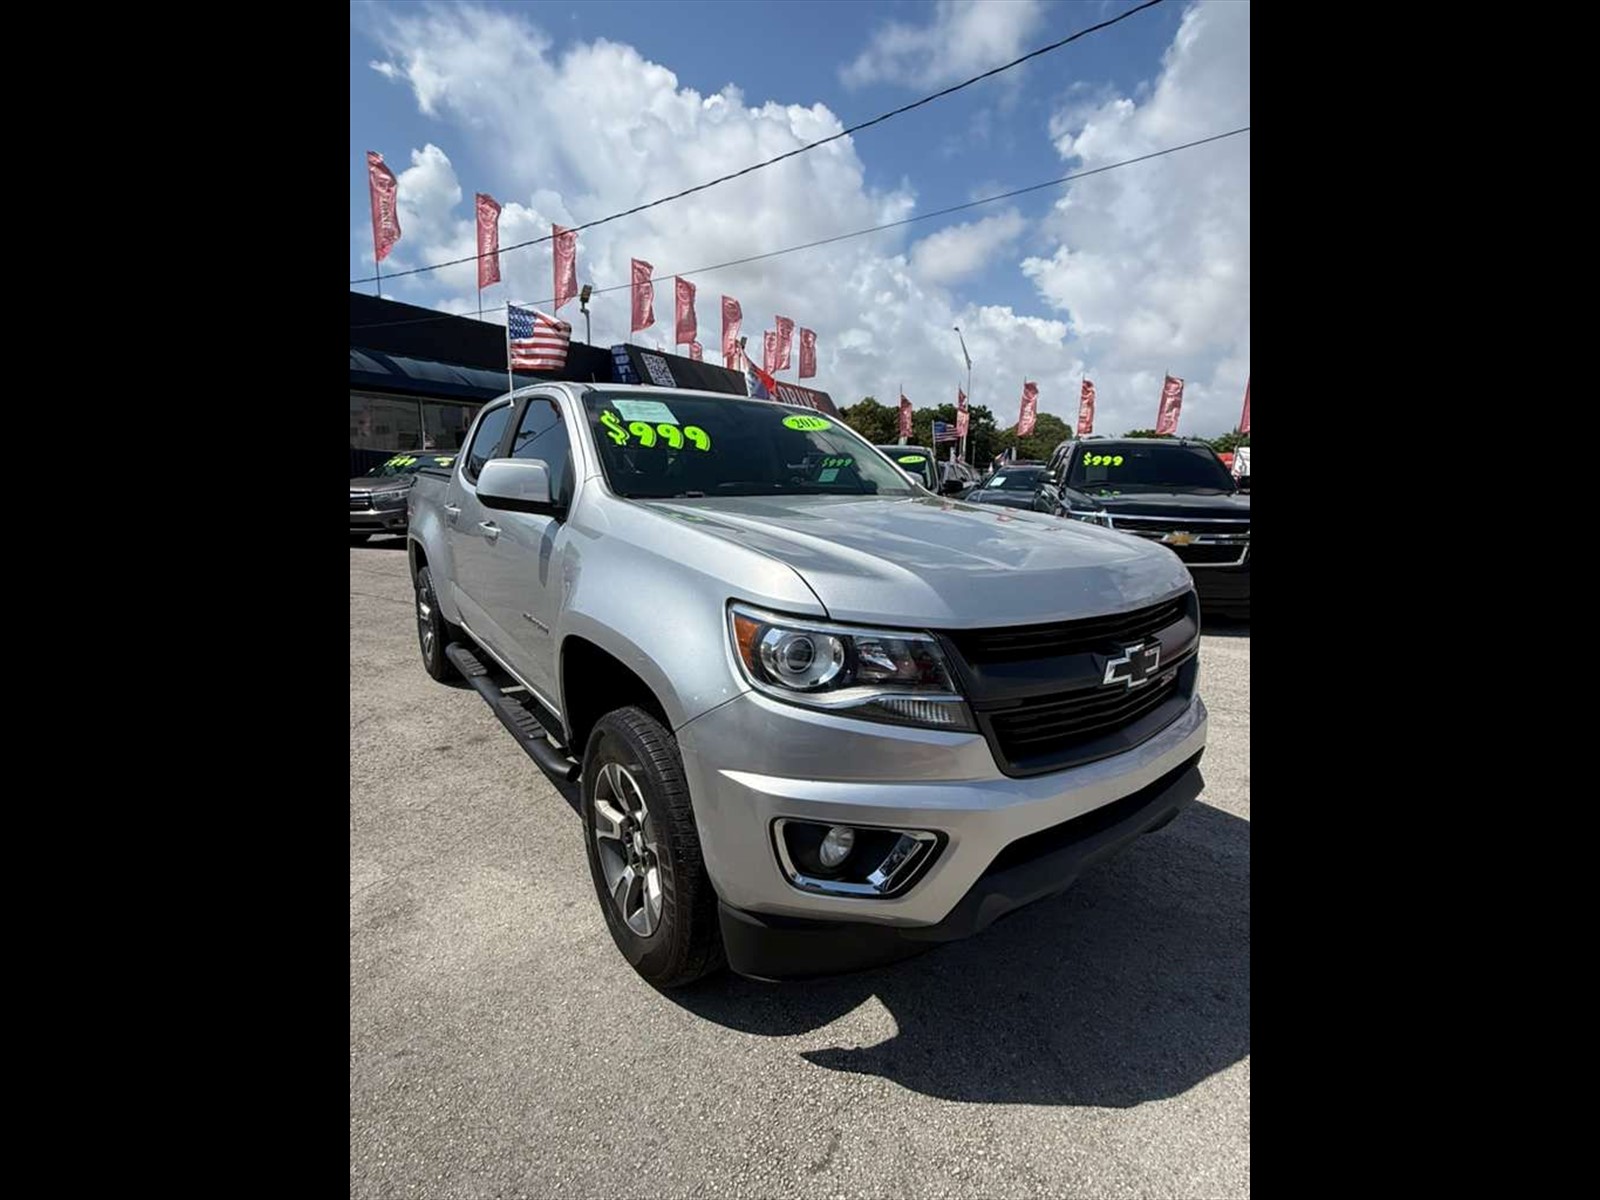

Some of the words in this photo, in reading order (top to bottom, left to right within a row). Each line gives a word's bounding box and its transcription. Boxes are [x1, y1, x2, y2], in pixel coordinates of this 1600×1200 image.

[777, 385, 818, 409] DRIVE
[600, 410, 710, 452] $999
[1083, 452, 1123, 466] $999
